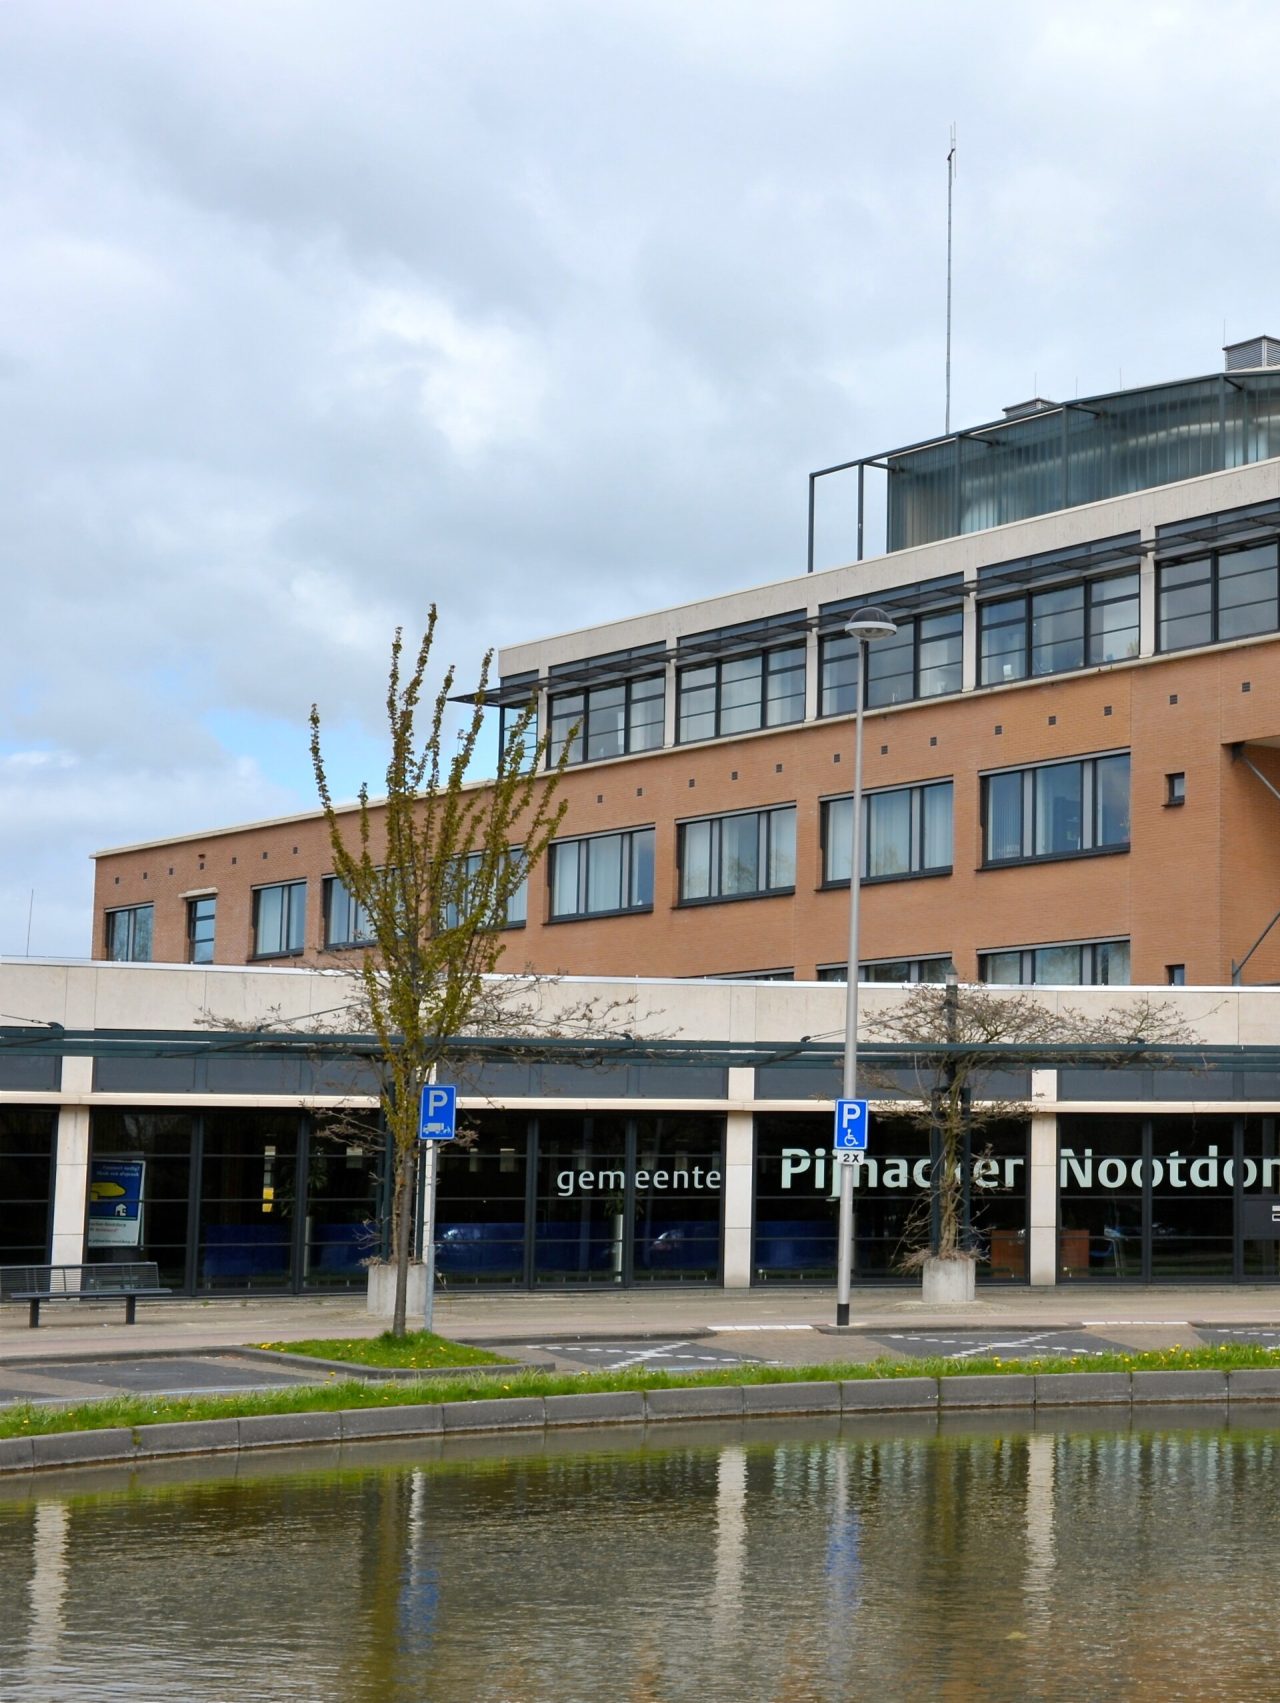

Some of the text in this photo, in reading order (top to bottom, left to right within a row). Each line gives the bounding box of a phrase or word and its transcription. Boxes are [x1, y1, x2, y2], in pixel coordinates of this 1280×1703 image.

[429, 1090, 448, 1117] P
[842, 1103, 861, 1128] P
[556, 1165, 721, 1197] gemeente
